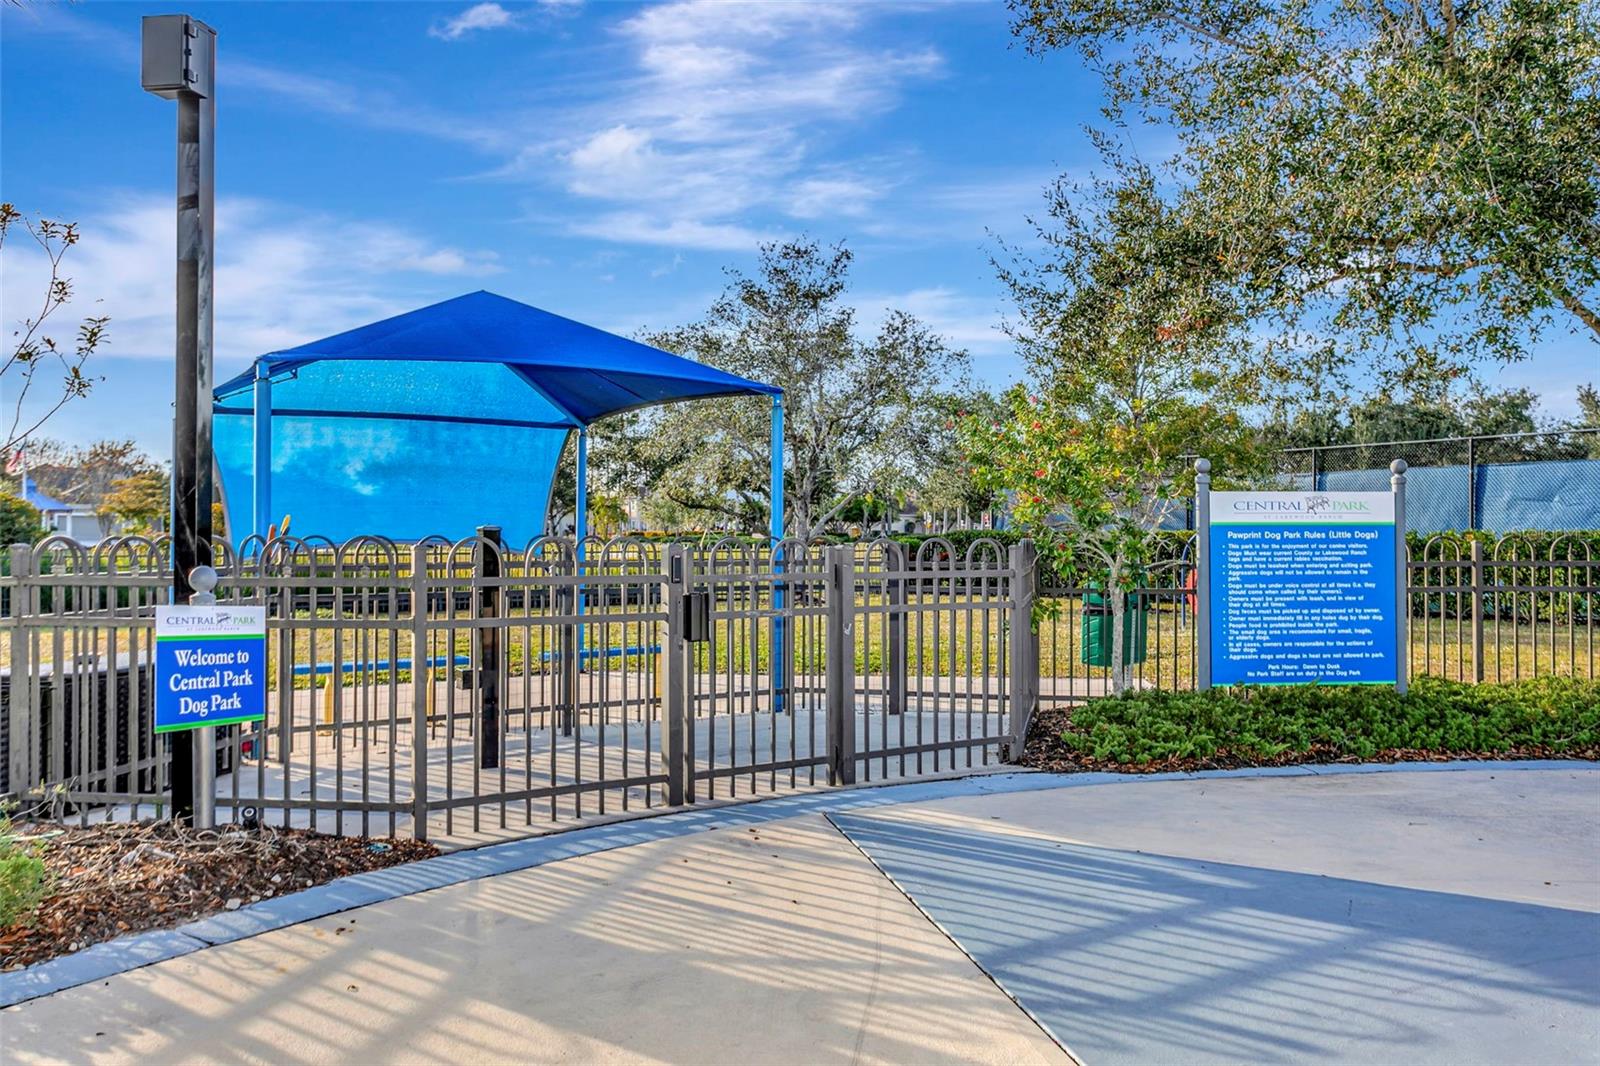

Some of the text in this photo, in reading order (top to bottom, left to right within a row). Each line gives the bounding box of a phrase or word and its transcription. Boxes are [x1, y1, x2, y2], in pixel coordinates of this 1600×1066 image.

[1234, 500, 1368, 510] CENTRAL PARK
[1227, 531, 1261, 540] Pawprint
[1264, 531, 1281, 539] Dog
[1329, 531, 1352, 539] (Little
[1354, 531, 1378, 539] Dogs)
[166, 616, 256, 625] CENTRAL PARK
[174, 648, 250, 667] Welcome to
[169, 669, 253, 692] Central Park
[179, 692, 242, 716] Dog Park
